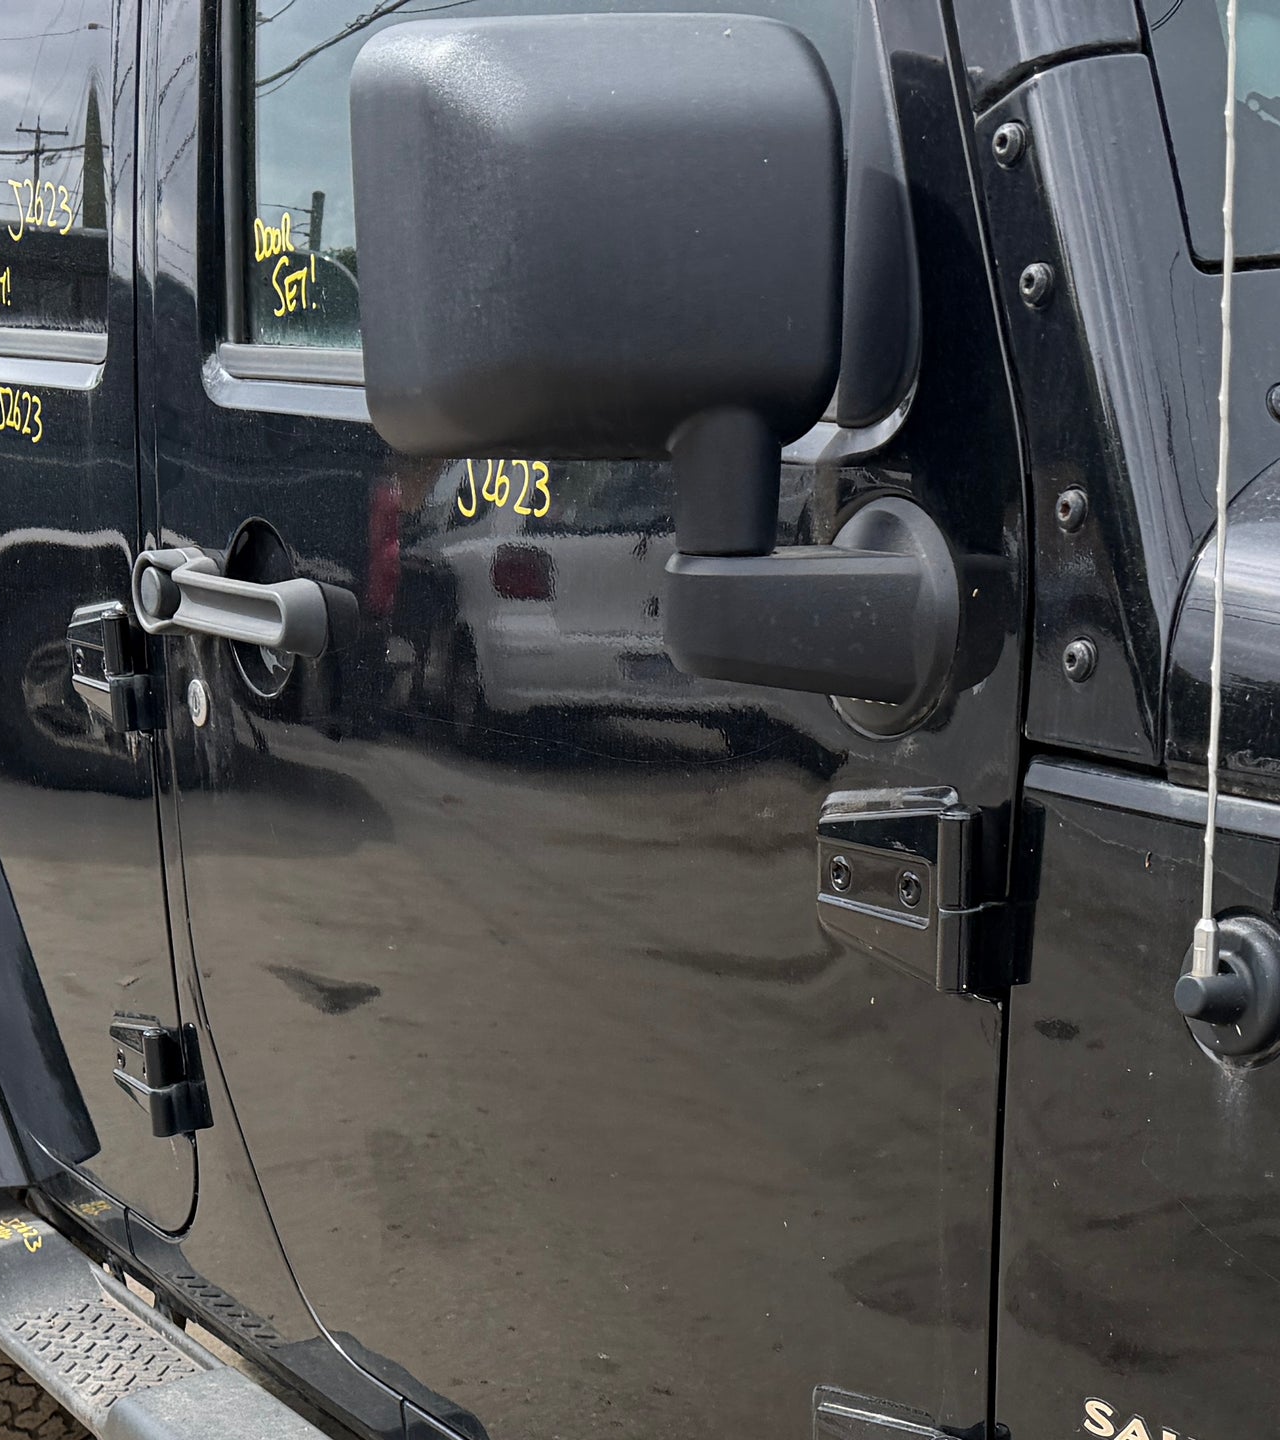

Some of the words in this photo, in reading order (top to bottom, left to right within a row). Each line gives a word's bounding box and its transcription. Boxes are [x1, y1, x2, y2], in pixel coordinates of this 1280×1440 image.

[7, 179, 73, 241] J2623
[254, 211, 295, 262] DOOR
[272, 253, 317, 317] SET!
[457, 459, 551, 518] J2623
